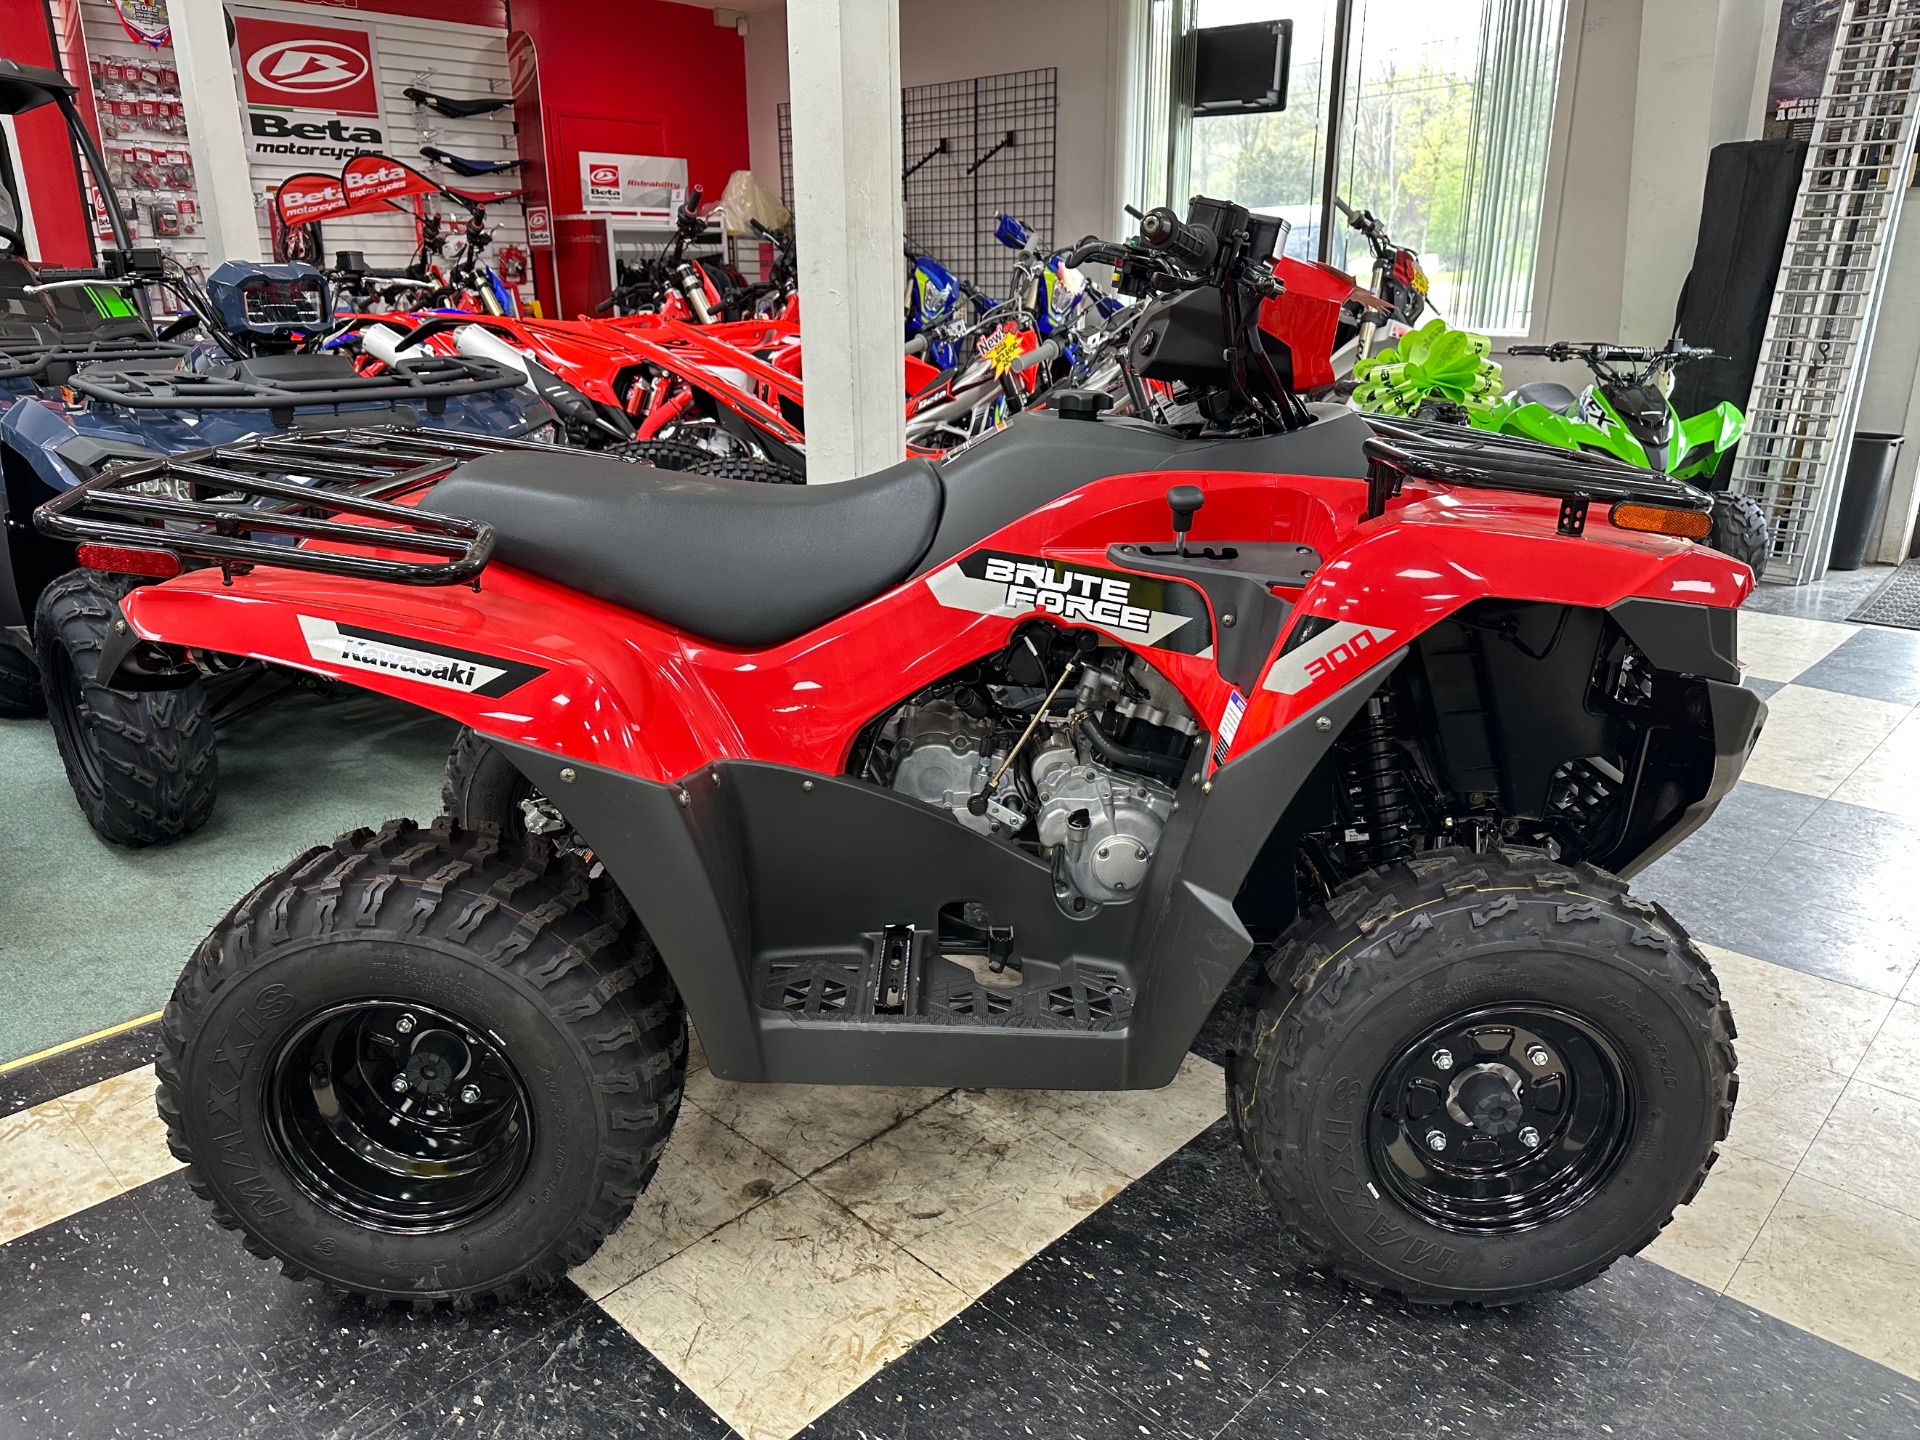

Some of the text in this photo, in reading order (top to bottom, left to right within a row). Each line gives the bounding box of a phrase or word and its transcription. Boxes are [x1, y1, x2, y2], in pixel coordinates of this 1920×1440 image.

[249, 112, 383, 144] Beta
[255, 142, 384, 161] motorcycles
[345, 166, 406, 189] Beta
[350, 180, 406, 199] motorcycles
[591, 188, 621, 196] Beta
[627, 179, 680, 189] Rideability
[979, 329, 1005, 355] New!
[984, 557, 1131, 605] BRUTE
[1006, 584, 1150, 633] FORCE
[341, 639, 477, 686] Kawasaki
[1303, 628, 1378, 683] 300
[206, 983, 297, 1221] MAXXIS
[1324, 1075, 1460, 1275] MAXXIS
